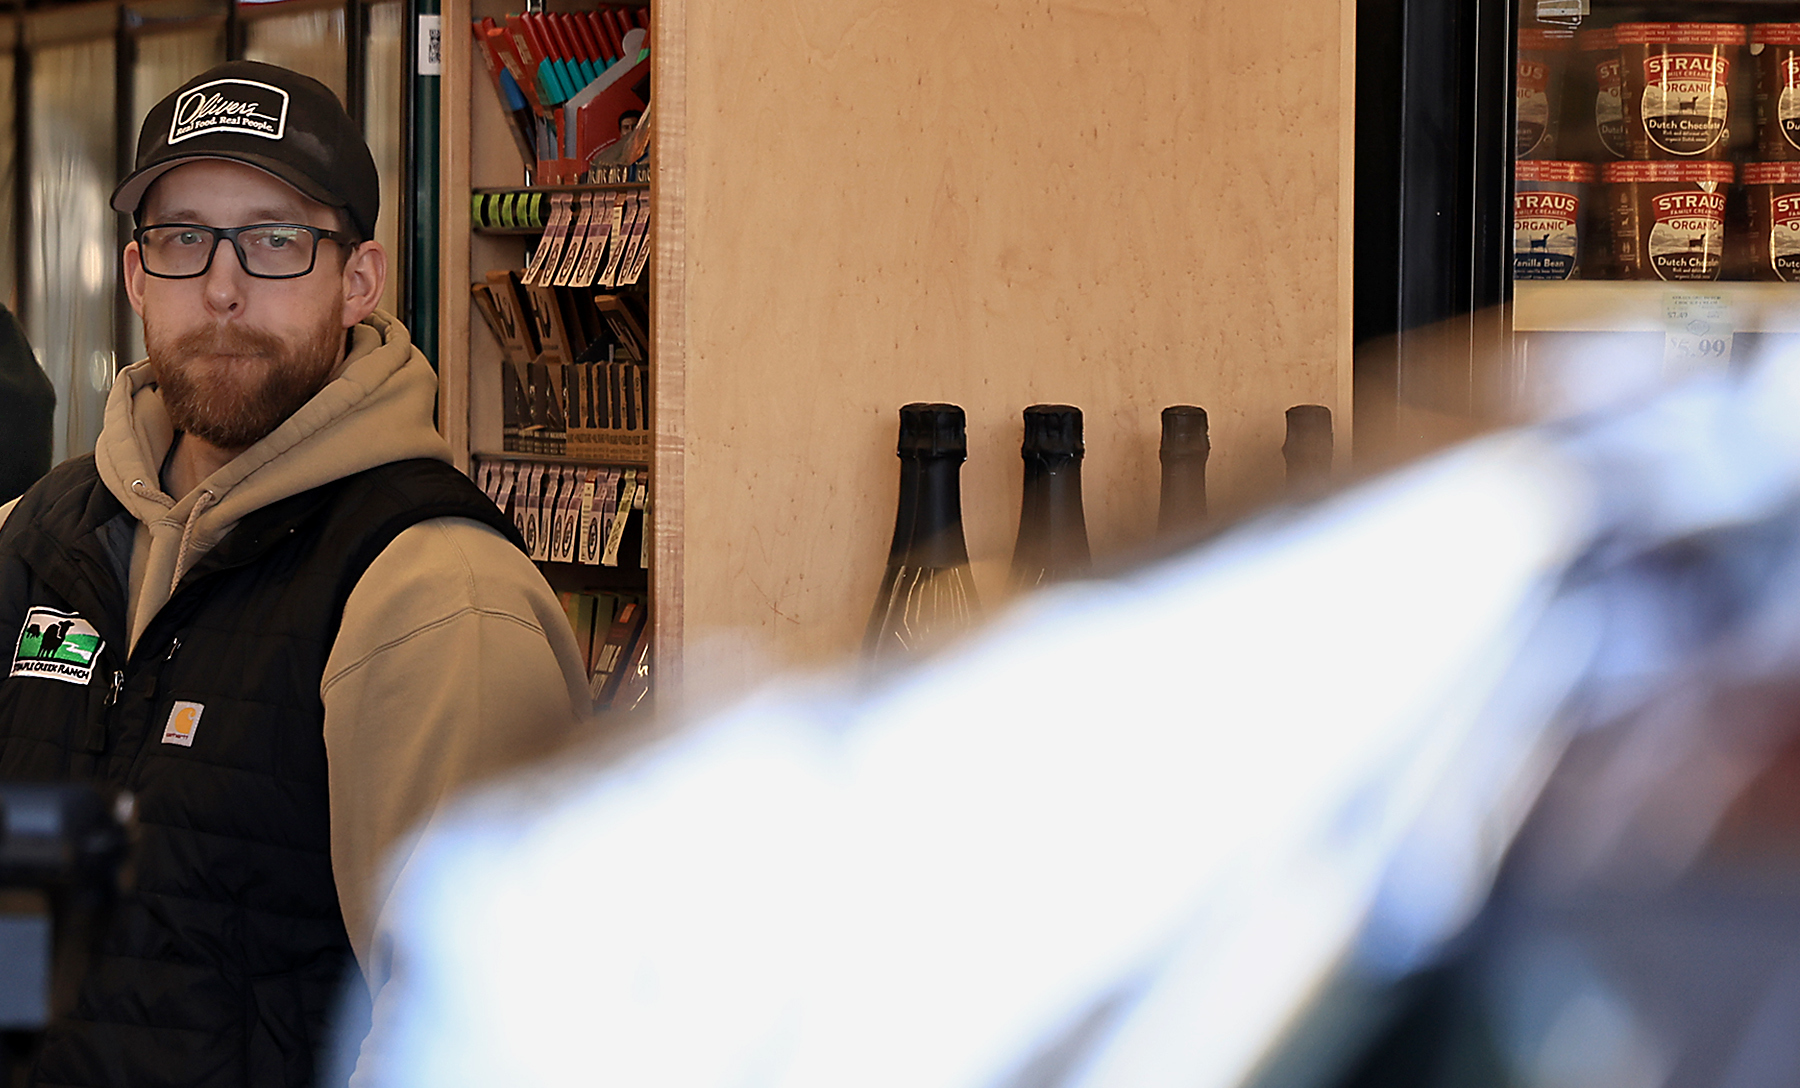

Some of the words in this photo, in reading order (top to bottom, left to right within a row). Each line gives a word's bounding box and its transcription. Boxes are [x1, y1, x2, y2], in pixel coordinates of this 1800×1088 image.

[1649, 58, 1725, 74] STRAUS
[219, 116, 241, 125] Real
[242, 117, 274, 132] People.
[1649, 119, 1677, 129] Dutch
[1514, 196, 1575, 212] TRAUS
[1659, 195, 1725, 212] STRAUS
[1515, 221, 1564, 231] ORGANIC
[1671, 220, 1718, 231] ORGANIC
[1543, 258, 1564, 267] Bean
[1657, 256, 1687, 267] Dutch
[1778, 258, 1800, 268] Dutc
[58, 664, 89, 680] RANCH
